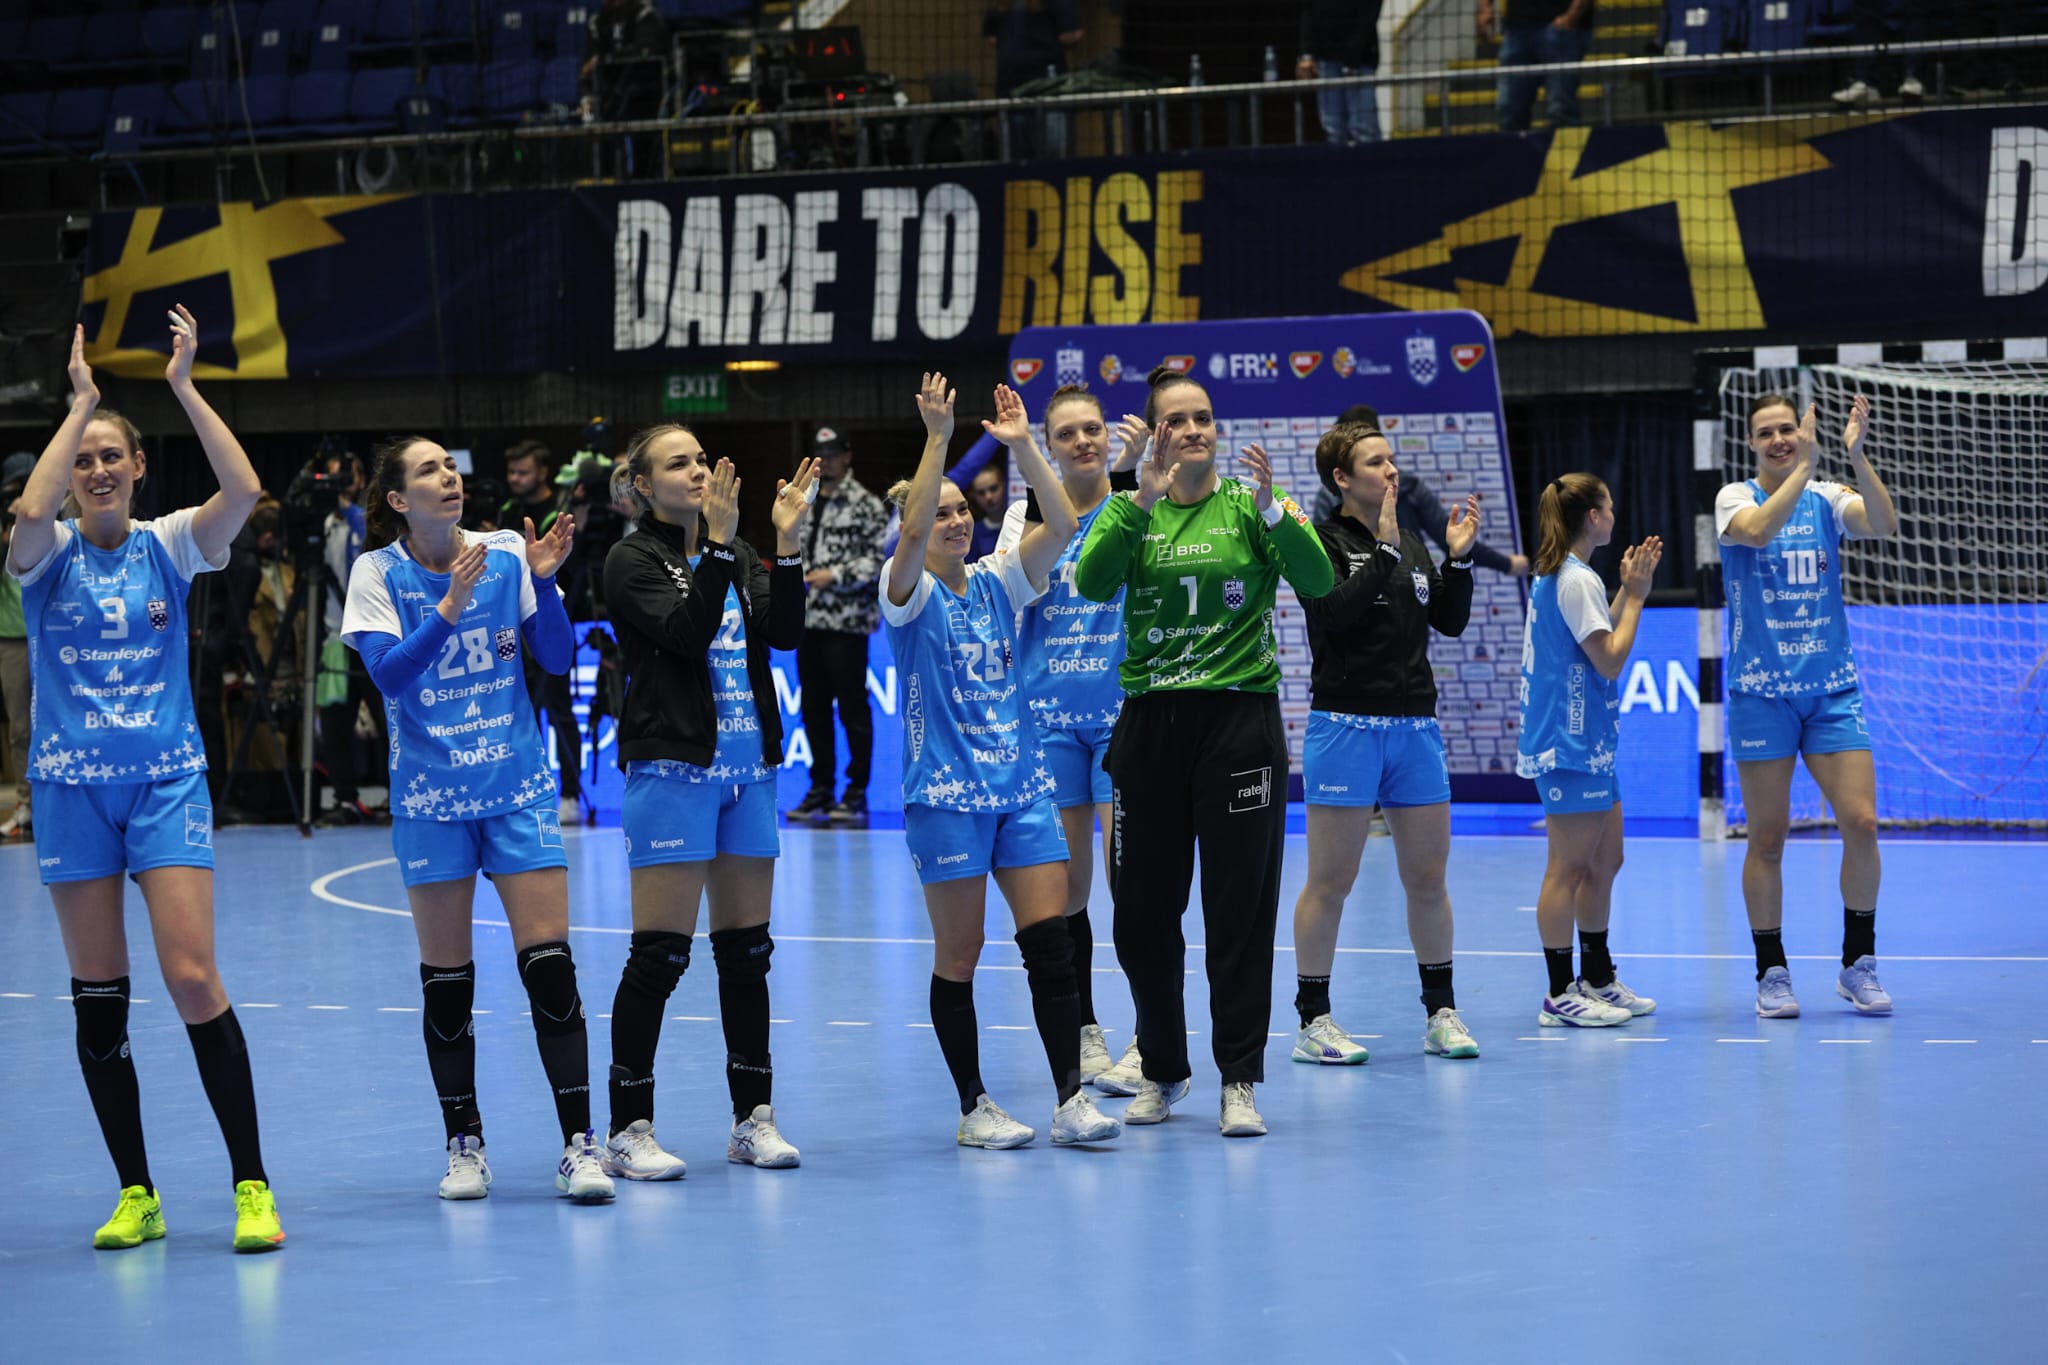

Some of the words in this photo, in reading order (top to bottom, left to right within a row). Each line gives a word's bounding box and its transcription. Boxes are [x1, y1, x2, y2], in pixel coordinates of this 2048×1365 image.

[614, 190, 838, 351] DARE
[862, 183, 980, 342] TO
[997, 169, 1204, 335] RISE
[669, 375, 720, 398] EXIT
[1787, 525, 1814, 536] BRD
[1176, 543, 1212, 557] BRD
[1781, 550, 1818, 585] 10
[1224, 580, 1244, 592] CSM
[1179, 576, 1198, 616] 1
[101, 596, 130, 640] 3
[1053, 602, 1121, 617] Stanleybet
[494, 628, 516, 645] CSM
[80, 645, 161, 662] Stanleybe
[437, 626, 494, 681] 28
[959, 639, 1006, 681] 25
[1048, 657, 1110, 674] BORSEC
[437, 673, 516, 702] Stanleybe
[85, 710, 158, 730] BORSEC
[426, 711, 515, 738] Wienerberg
[1319, 783, 1348, 793] Kempa
[651, 838, 684, 849] Kempa
[937, 853, 969, 866] Kempa
